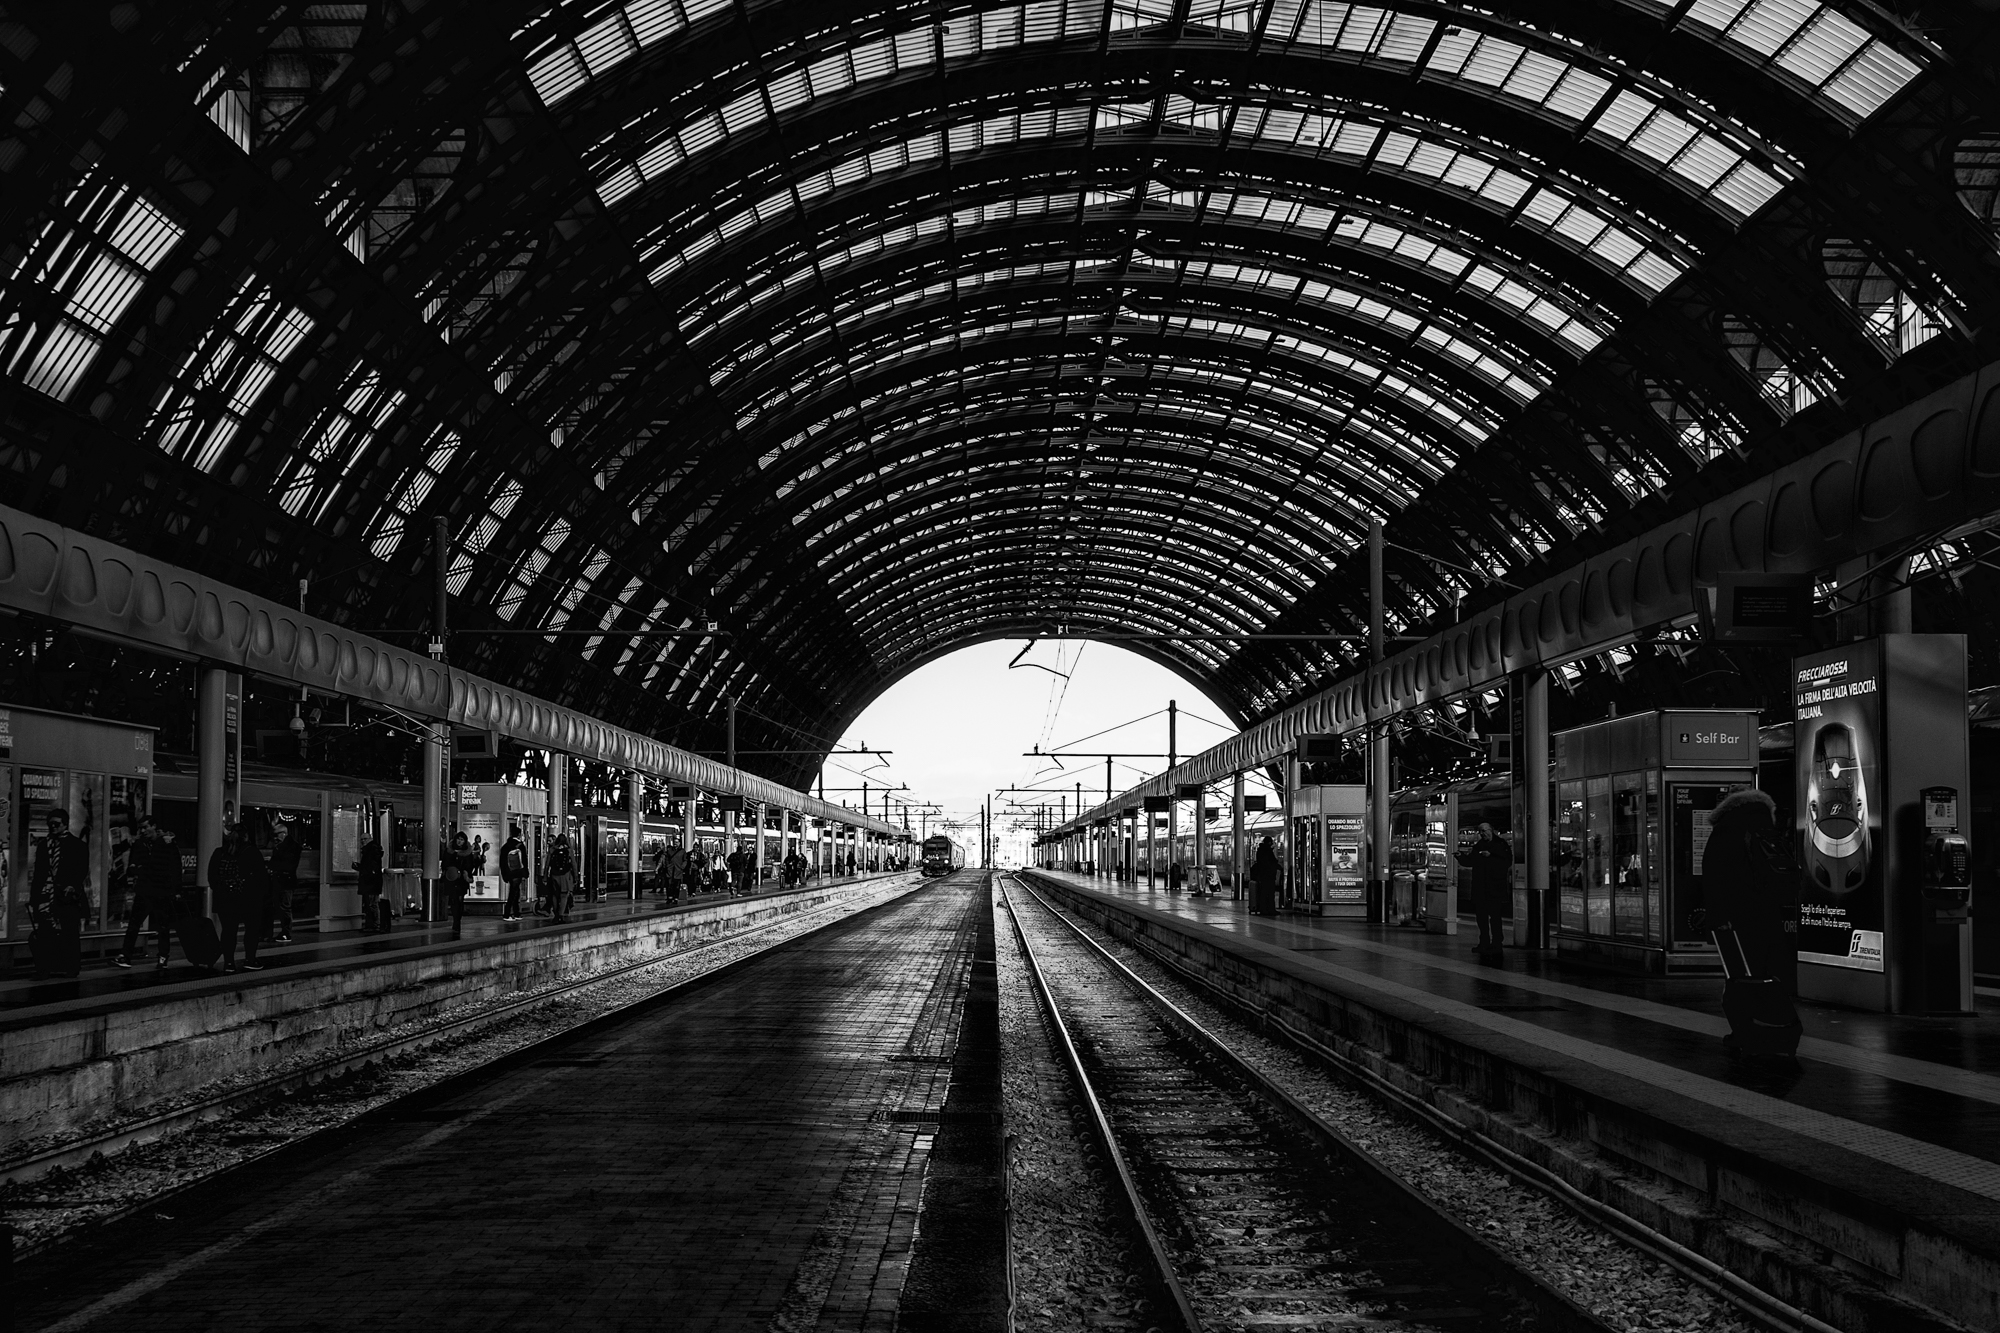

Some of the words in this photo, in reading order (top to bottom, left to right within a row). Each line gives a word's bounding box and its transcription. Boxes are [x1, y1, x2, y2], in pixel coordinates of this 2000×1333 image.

[1797, 660, 1848, 683] FRECCIAROSSA
[1797, 693, 1805, 706] LA
[1804, 690, 1822, 704] FIRMA
[1822, 685, 1848, 701] DELL'ALTA
[1848, 676, 1877, 696] VELOCITÀ
[1797, 705, 1823, 721] ITALIANA.
[1696, 732, 1718, 744] Self
[1720, 733, 1740, 744] Bar
[22, 773, 43, 786] QUANDO
[43, 775, 54, 787] NON
[24, 787, 31, 799] LO
[462, 785, 479, 793] your
[461, 797, 482, 805] break
